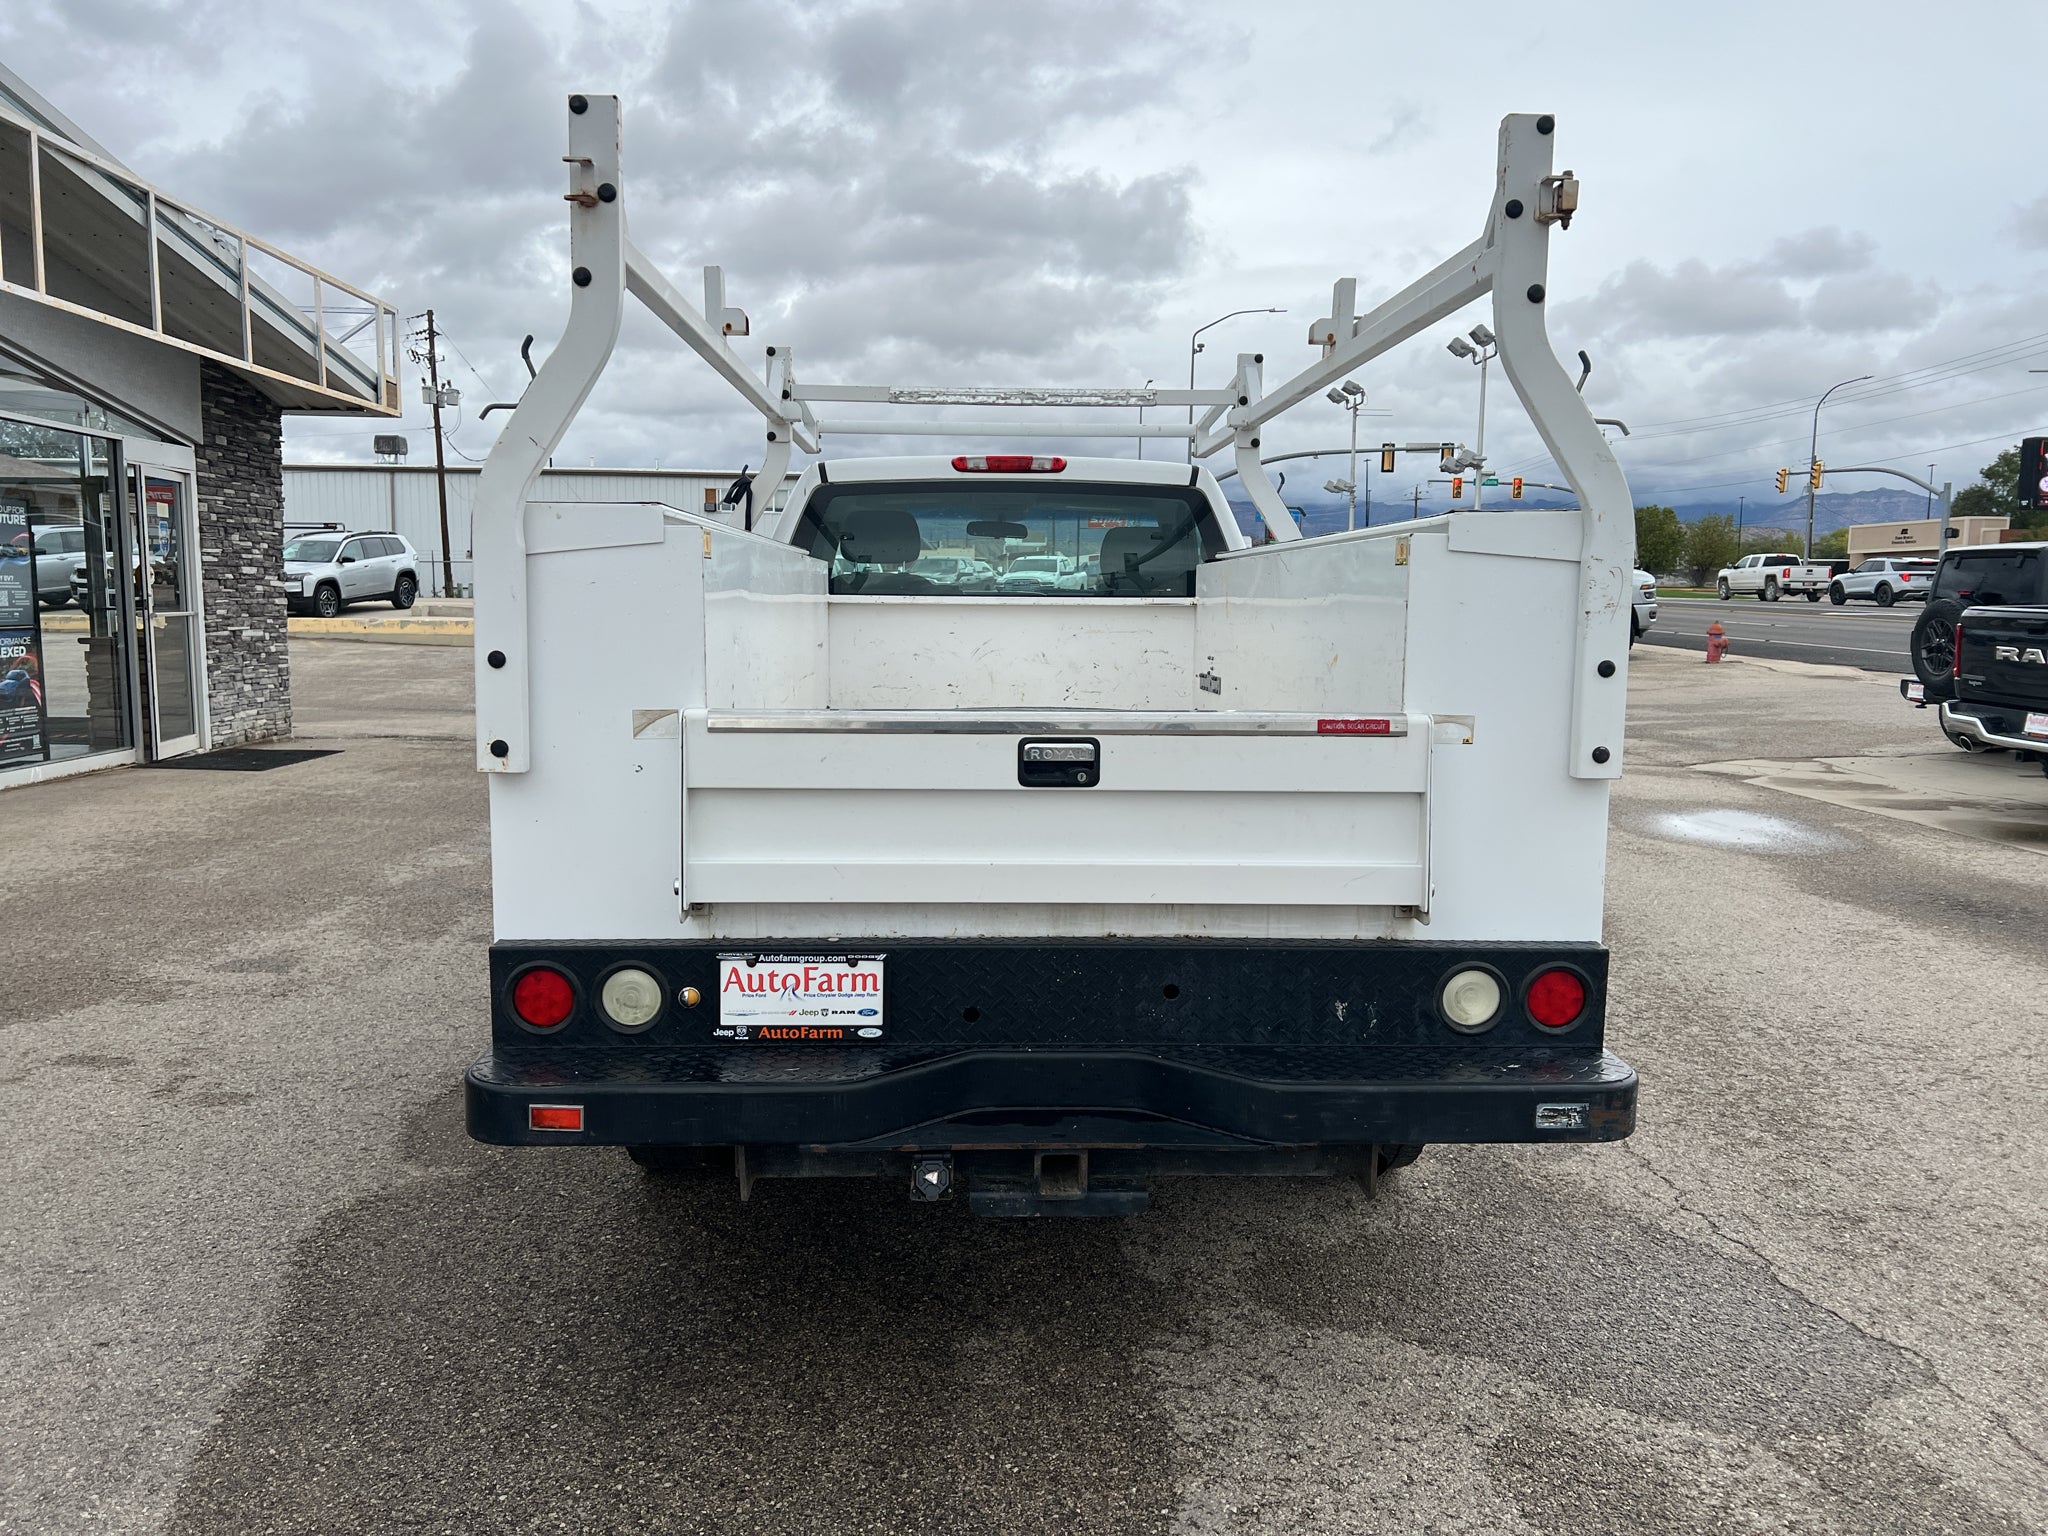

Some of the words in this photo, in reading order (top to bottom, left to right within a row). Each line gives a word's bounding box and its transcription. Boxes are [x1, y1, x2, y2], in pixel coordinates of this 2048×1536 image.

[12, 506, 24, 514] FOR
[0, 513, 26, 526] TURE
[0, 646, 26, 658] EXED
[1996, 646, 2048, 664] RA
[1030, 749, 1086, 760] ROYAL
[758, 954, 846, 963] Autofarmgroup.com
[722, 966, 880, 992] AutoFarm
[799, 1009, 820, 1017] Jeep
[713, 1028, 734, 1037] Jeep
[758, 1026, 843, 1039] AutoFarm
